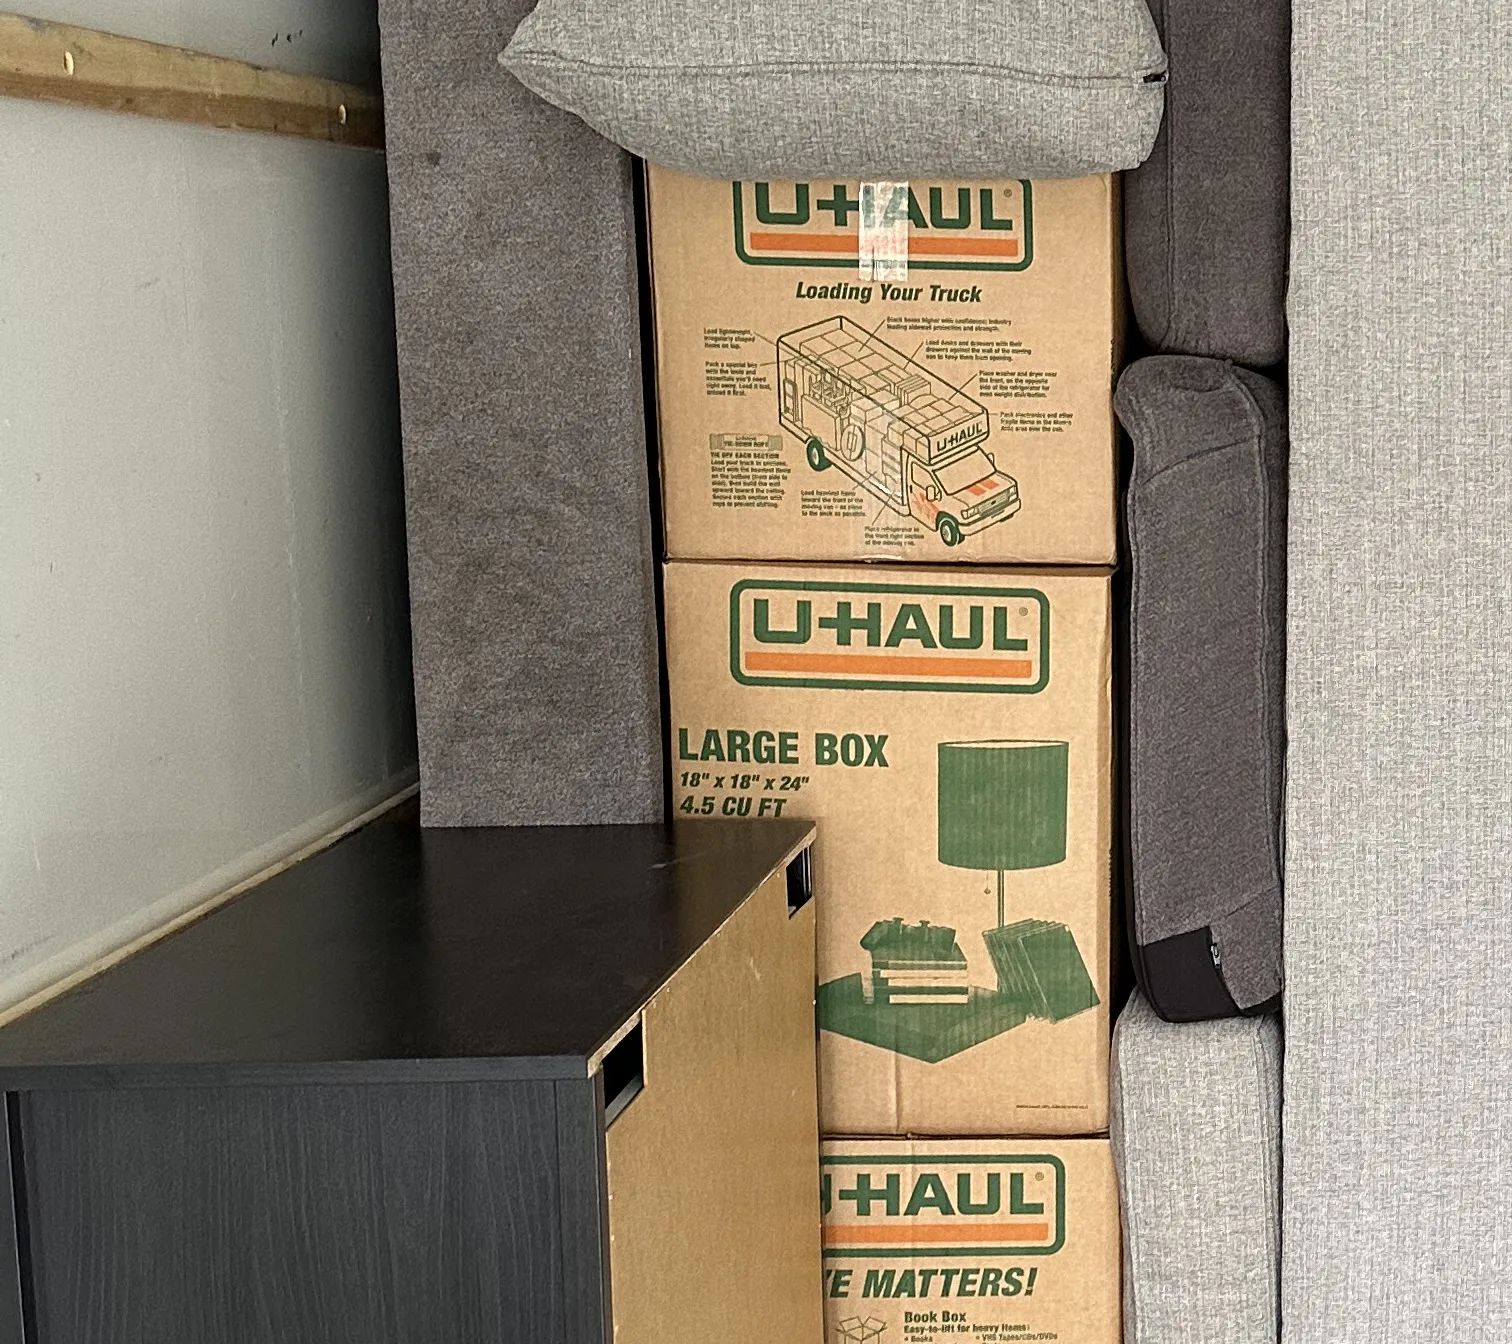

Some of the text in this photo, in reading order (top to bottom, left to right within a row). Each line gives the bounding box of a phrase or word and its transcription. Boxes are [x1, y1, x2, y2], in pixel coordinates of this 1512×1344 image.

[796, 281, 982, 304] Loading Your Truck
[936, 422, 983, 453] U-HAUL
[753, 598, 1029, 651] U-HAUL
[679, 728, 889, 767] LARGE BOX
[680, 772, 810, 792] 18" x 18" x 24"
[680, 795, 787, 818] 4.5 CU FT
[824, 1267, 1038, 1299] E MATTERS!
[904, 1310, 967, 1323] Book Box
[957, 1324, 970, 1333] for
